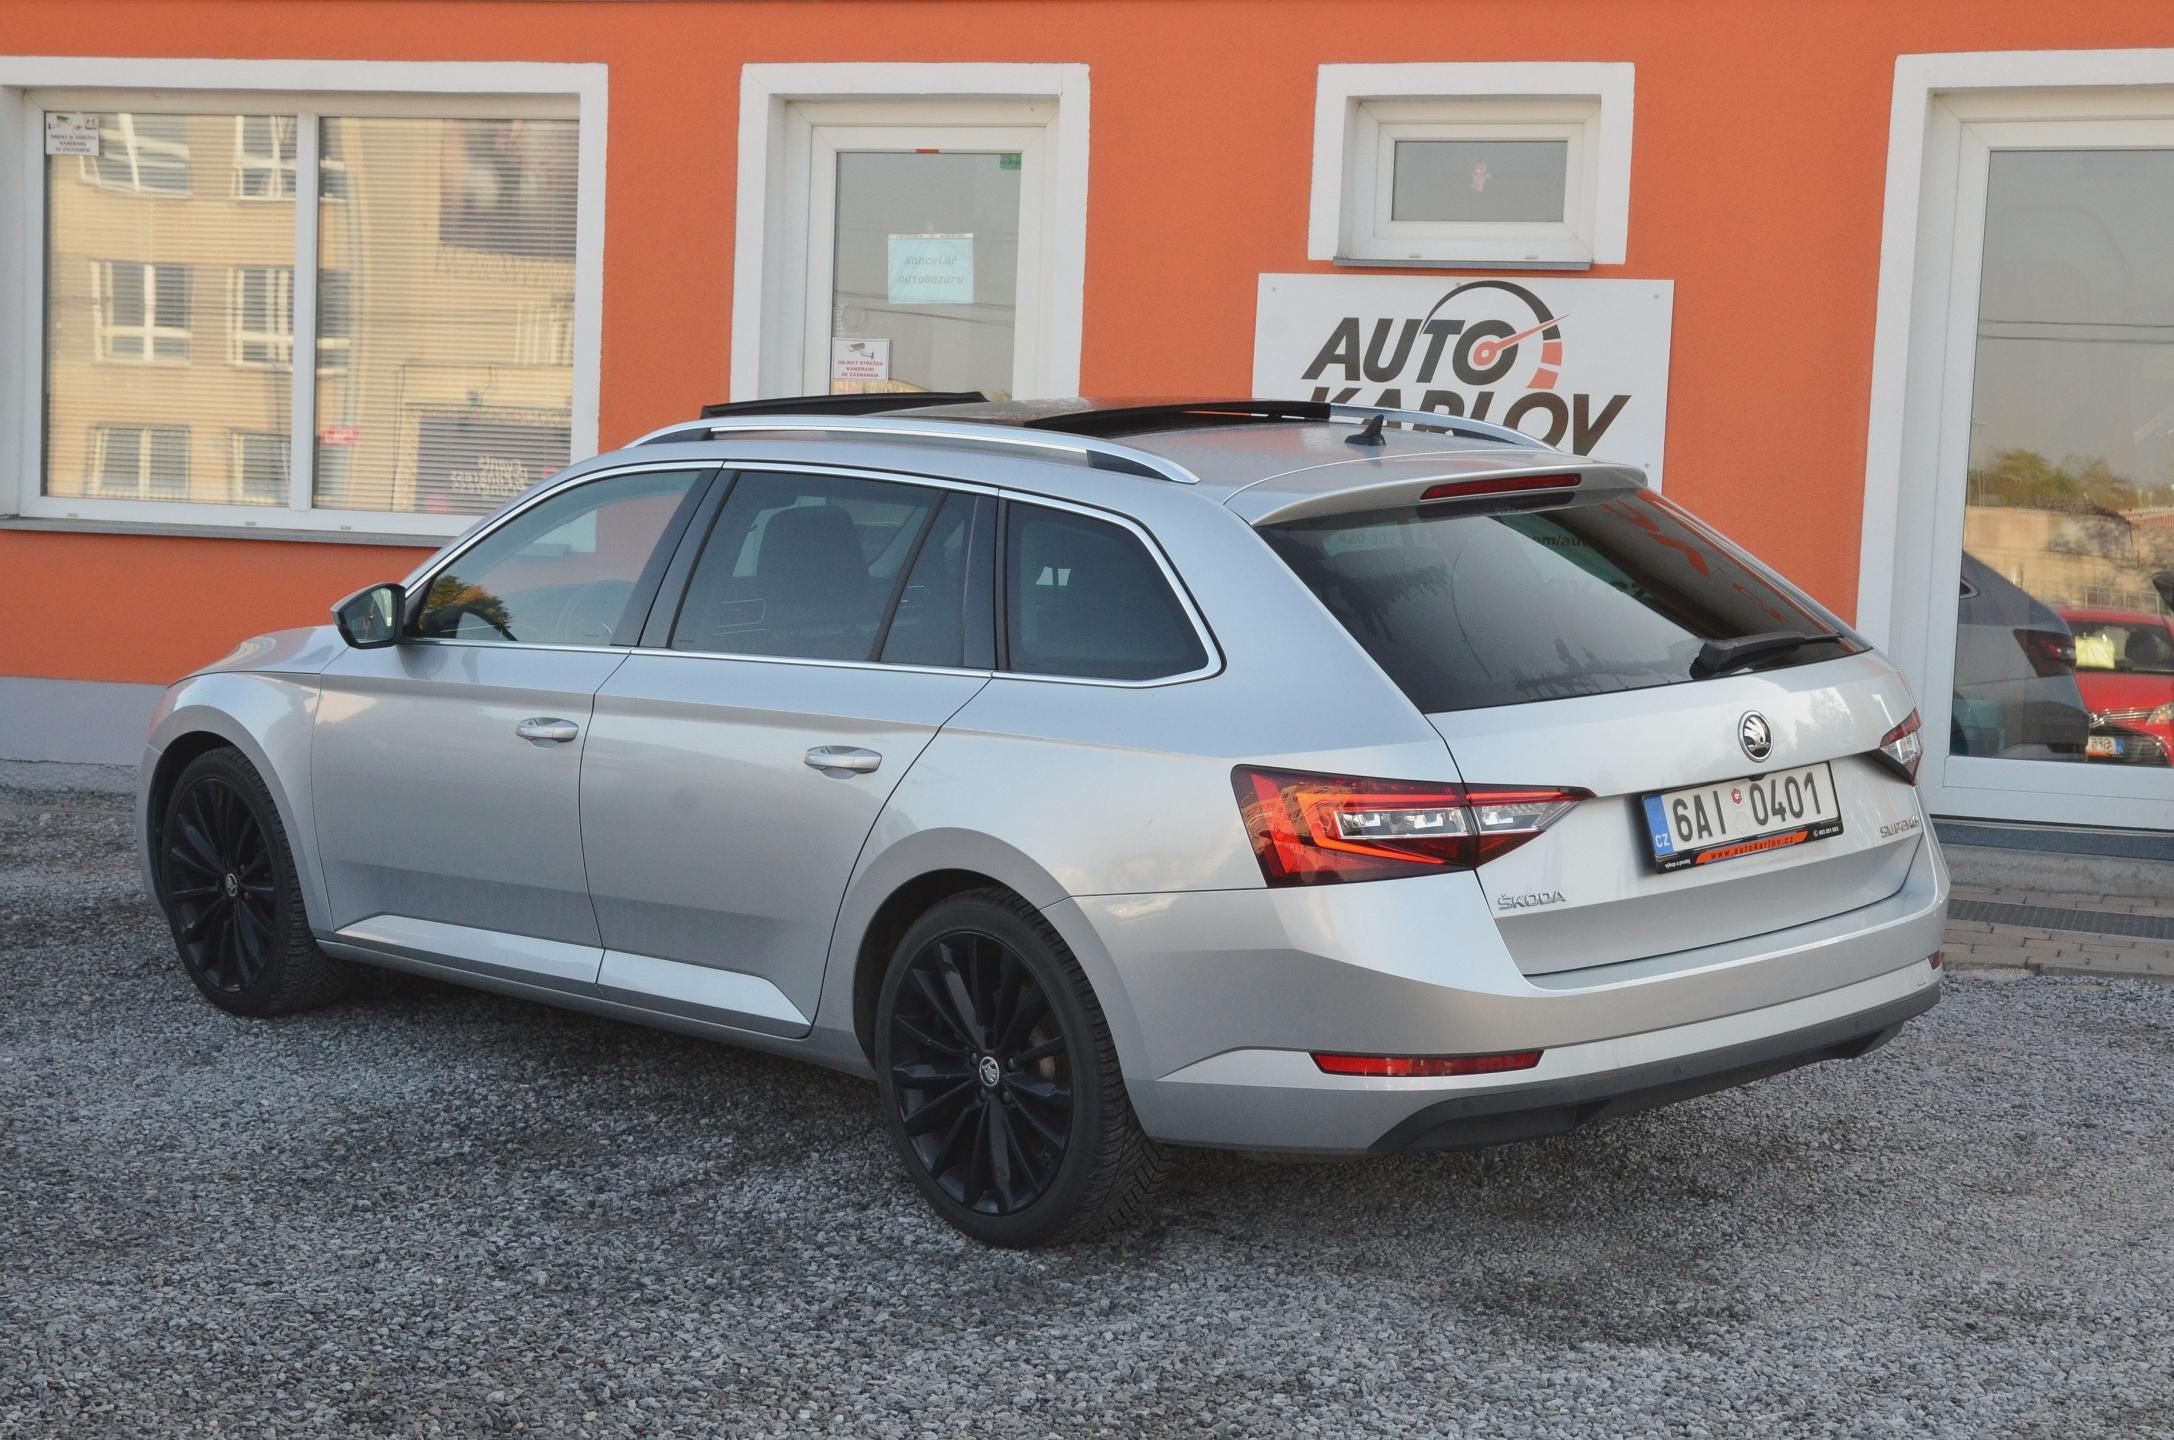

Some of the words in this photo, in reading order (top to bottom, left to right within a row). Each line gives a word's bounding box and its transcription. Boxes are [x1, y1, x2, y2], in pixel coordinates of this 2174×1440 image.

[1301, 317, 1519, 386] AUTO
[1310, 387, 1632, 457] ROV
[1655, 832, 1671, 848] CZ
[1750, 771, 1822, 826] 0401
[1710, 836, 1795, 860] www.autokarlov.cz
[1498, 890, 1567, 911] ŠKODA
